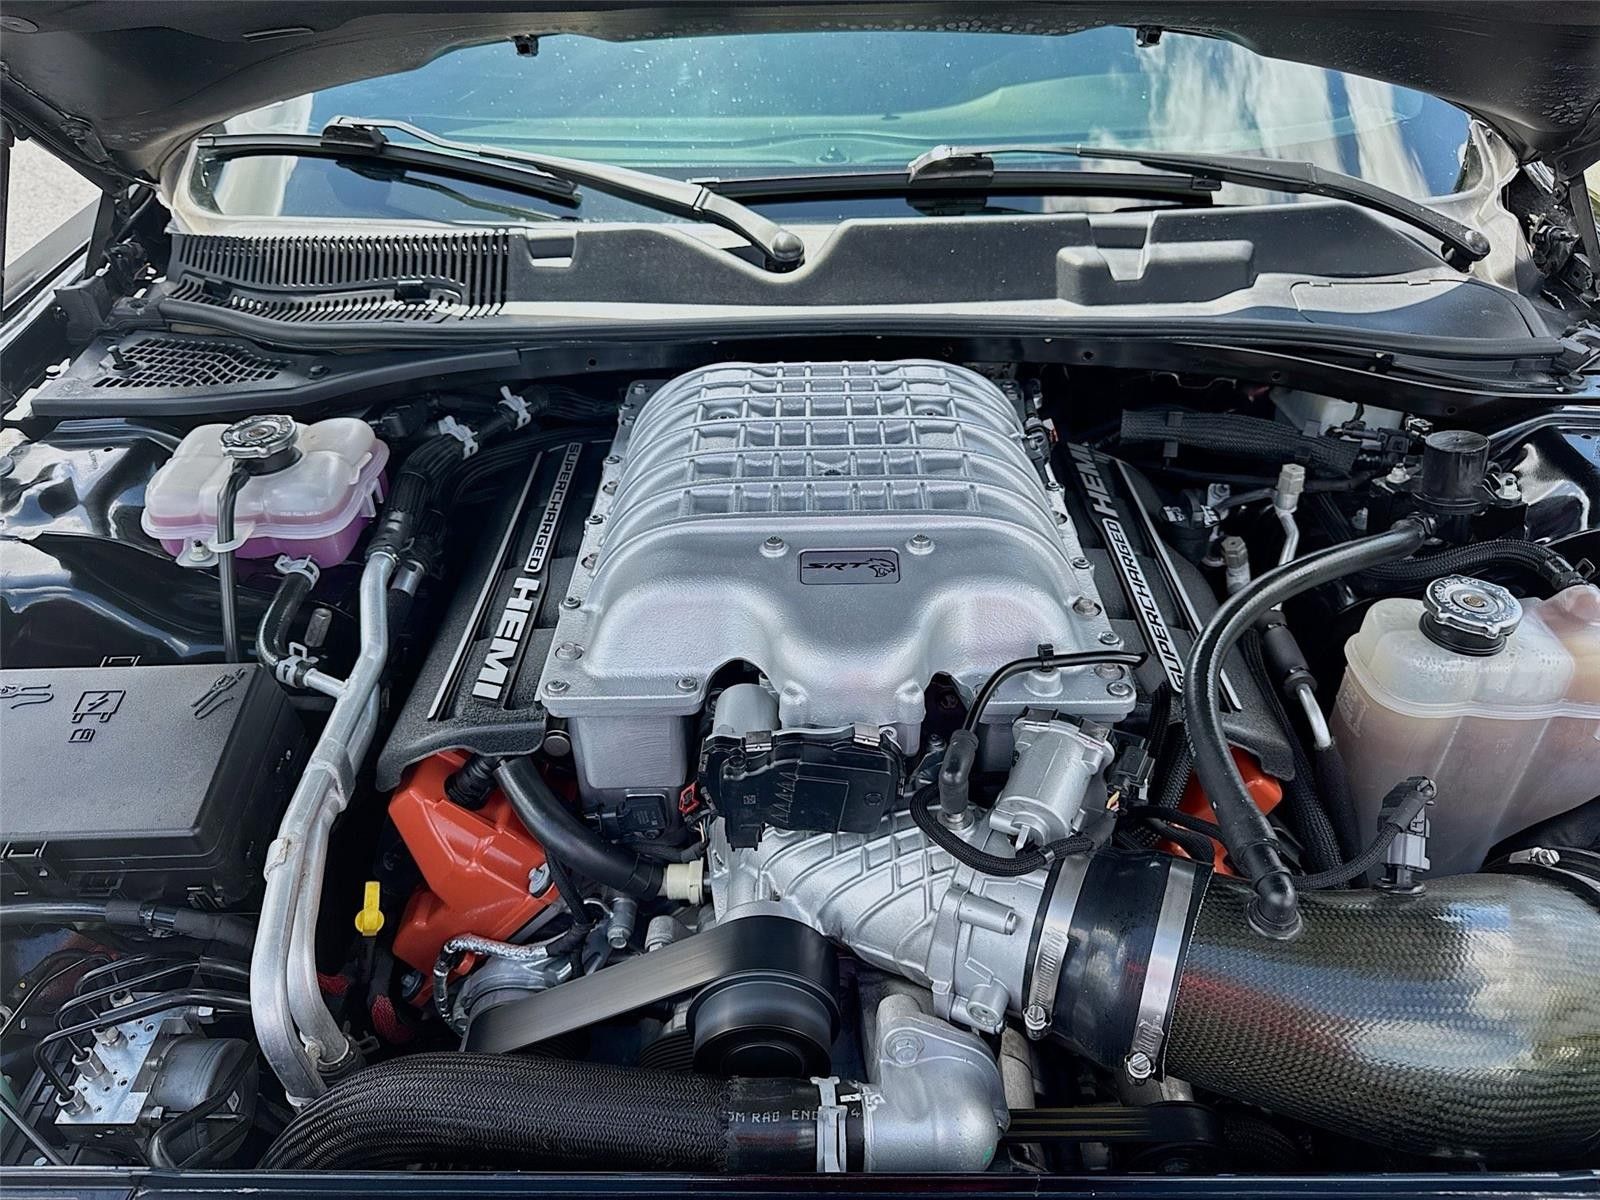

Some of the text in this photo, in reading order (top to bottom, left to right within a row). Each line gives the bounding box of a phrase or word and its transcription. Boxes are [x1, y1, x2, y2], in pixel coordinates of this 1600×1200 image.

[1067, 442, 1119, 518] HEMI
[472, 443, 582, 700] SUPERCHARGED HEMI
[803, 562, 869, 571] SRT
